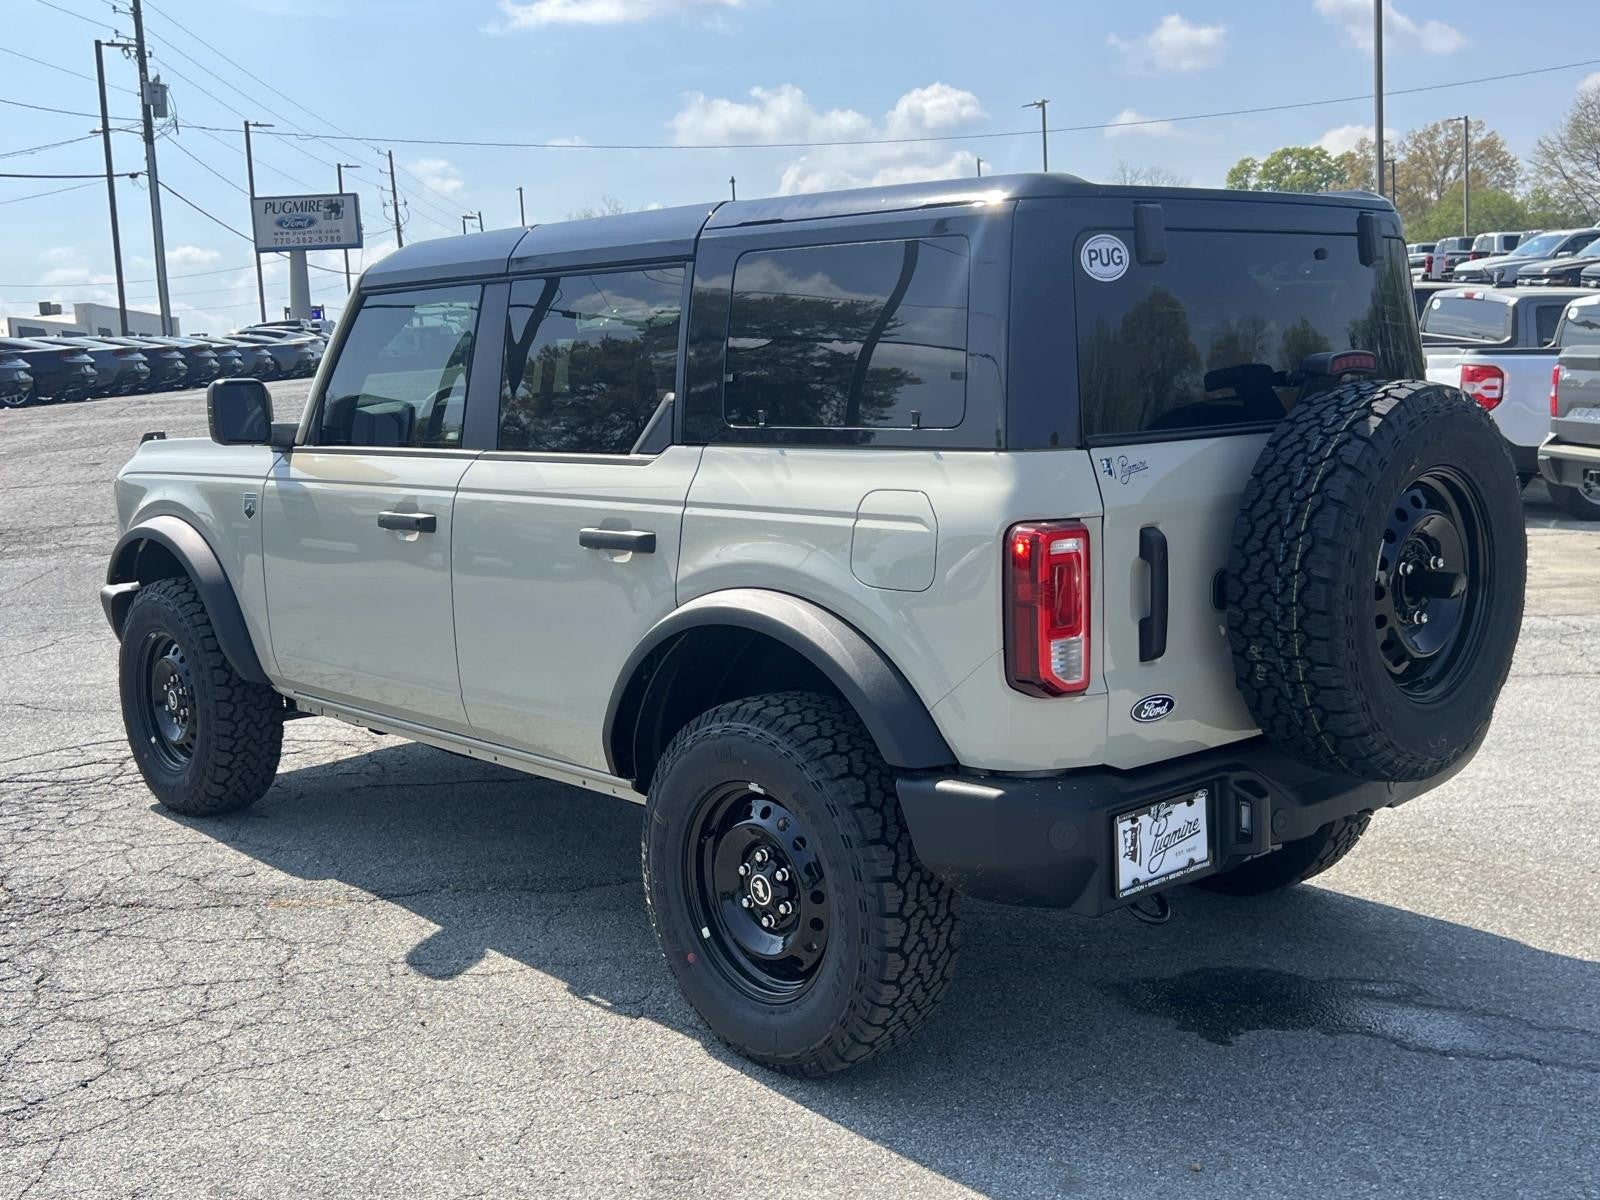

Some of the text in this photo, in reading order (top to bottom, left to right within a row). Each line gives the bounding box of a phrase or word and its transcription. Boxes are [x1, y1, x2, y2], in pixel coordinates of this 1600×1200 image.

[264, 199, 322, 214] PUGMIRE
[1087, 247, 1124, 268] PUG
[1140, 699, 1169, 718] Ford
[1148, 811, 1201, 874] Pugmire
